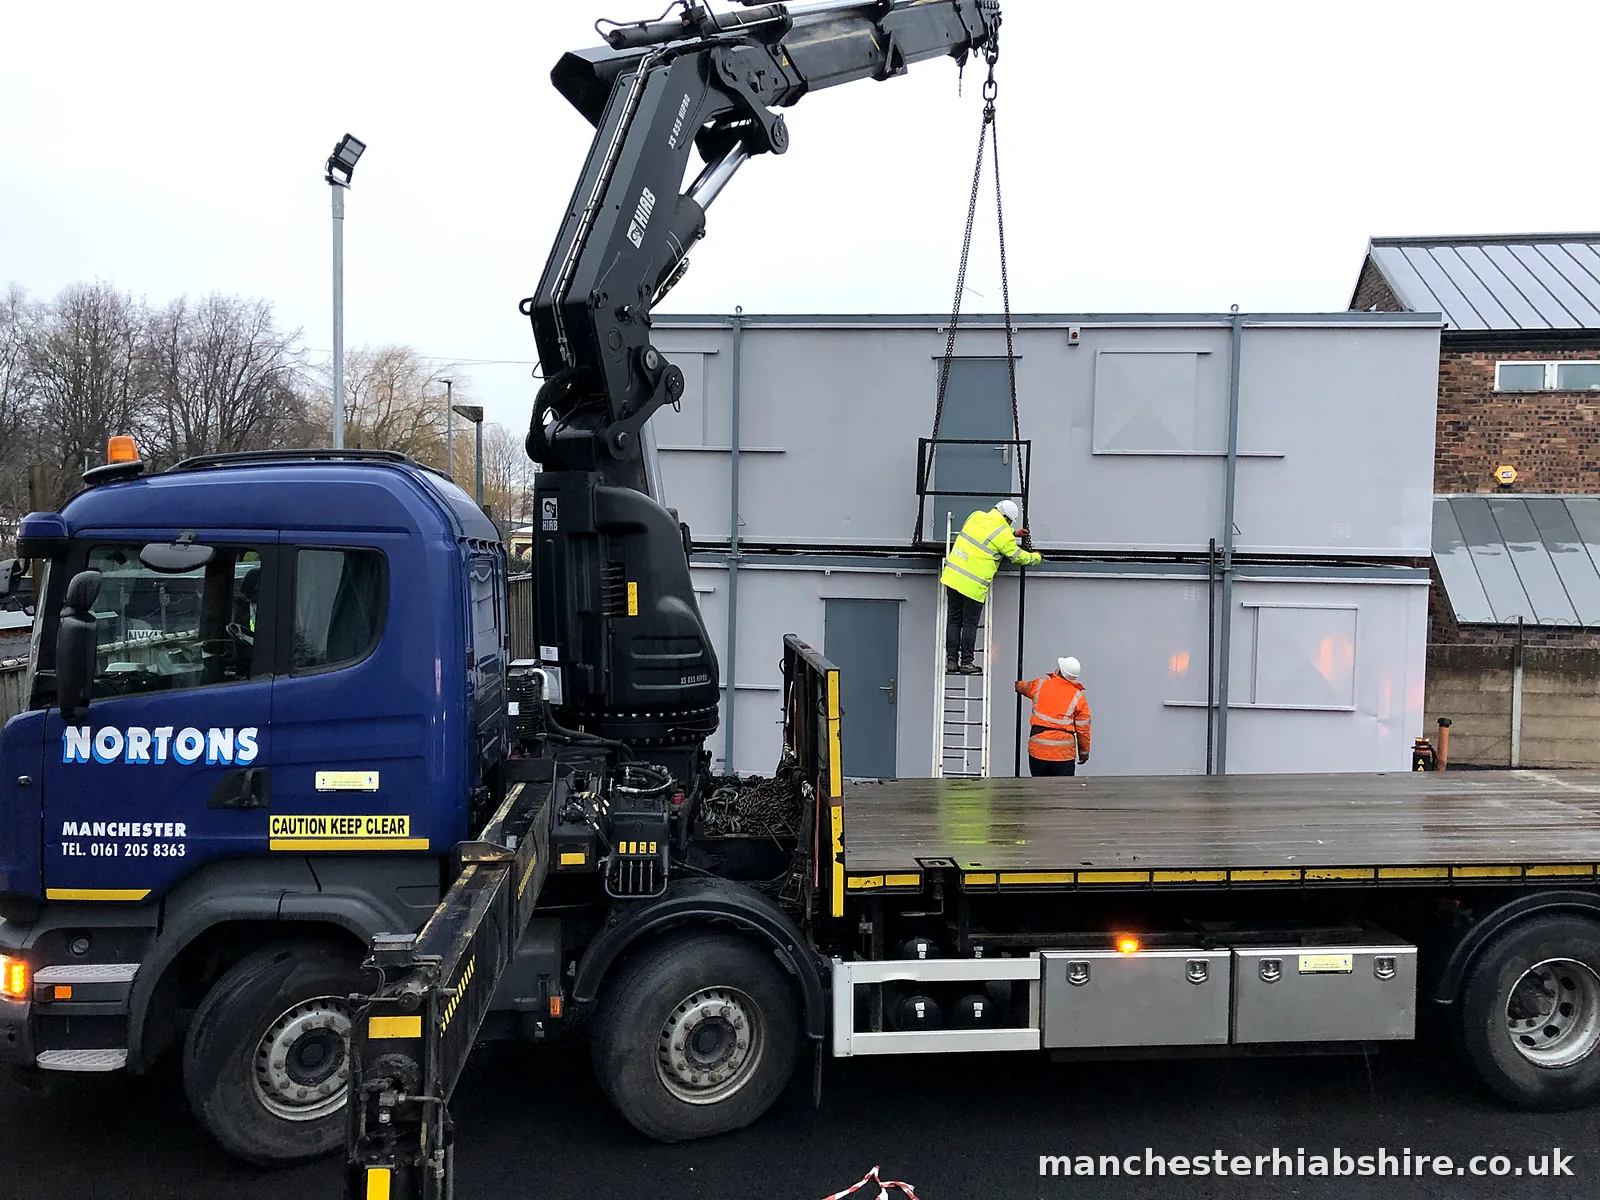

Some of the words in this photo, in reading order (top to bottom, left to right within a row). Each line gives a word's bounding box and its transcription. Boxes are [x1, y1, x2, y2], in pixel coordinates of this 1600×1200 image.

[668, 134, 677, 150] XS
[633, 186, 656, 230] HIAB
[542, 520, 558, 531] HIAB
[62, 725, 259, 766] NORTONS
[62, 821, 187, 837] MANCHESTER
[272, 818, 327, 834] CAUTION
[330, 818, 362, 834] KEEP
[366, 818, 406, 834] CLEAR
[61, 842, 87, 856] TEL.
[90, 842, 118, 857] 0161
[124, 843, 149, 857] 205
[153, 843, 186, 857] 8363
